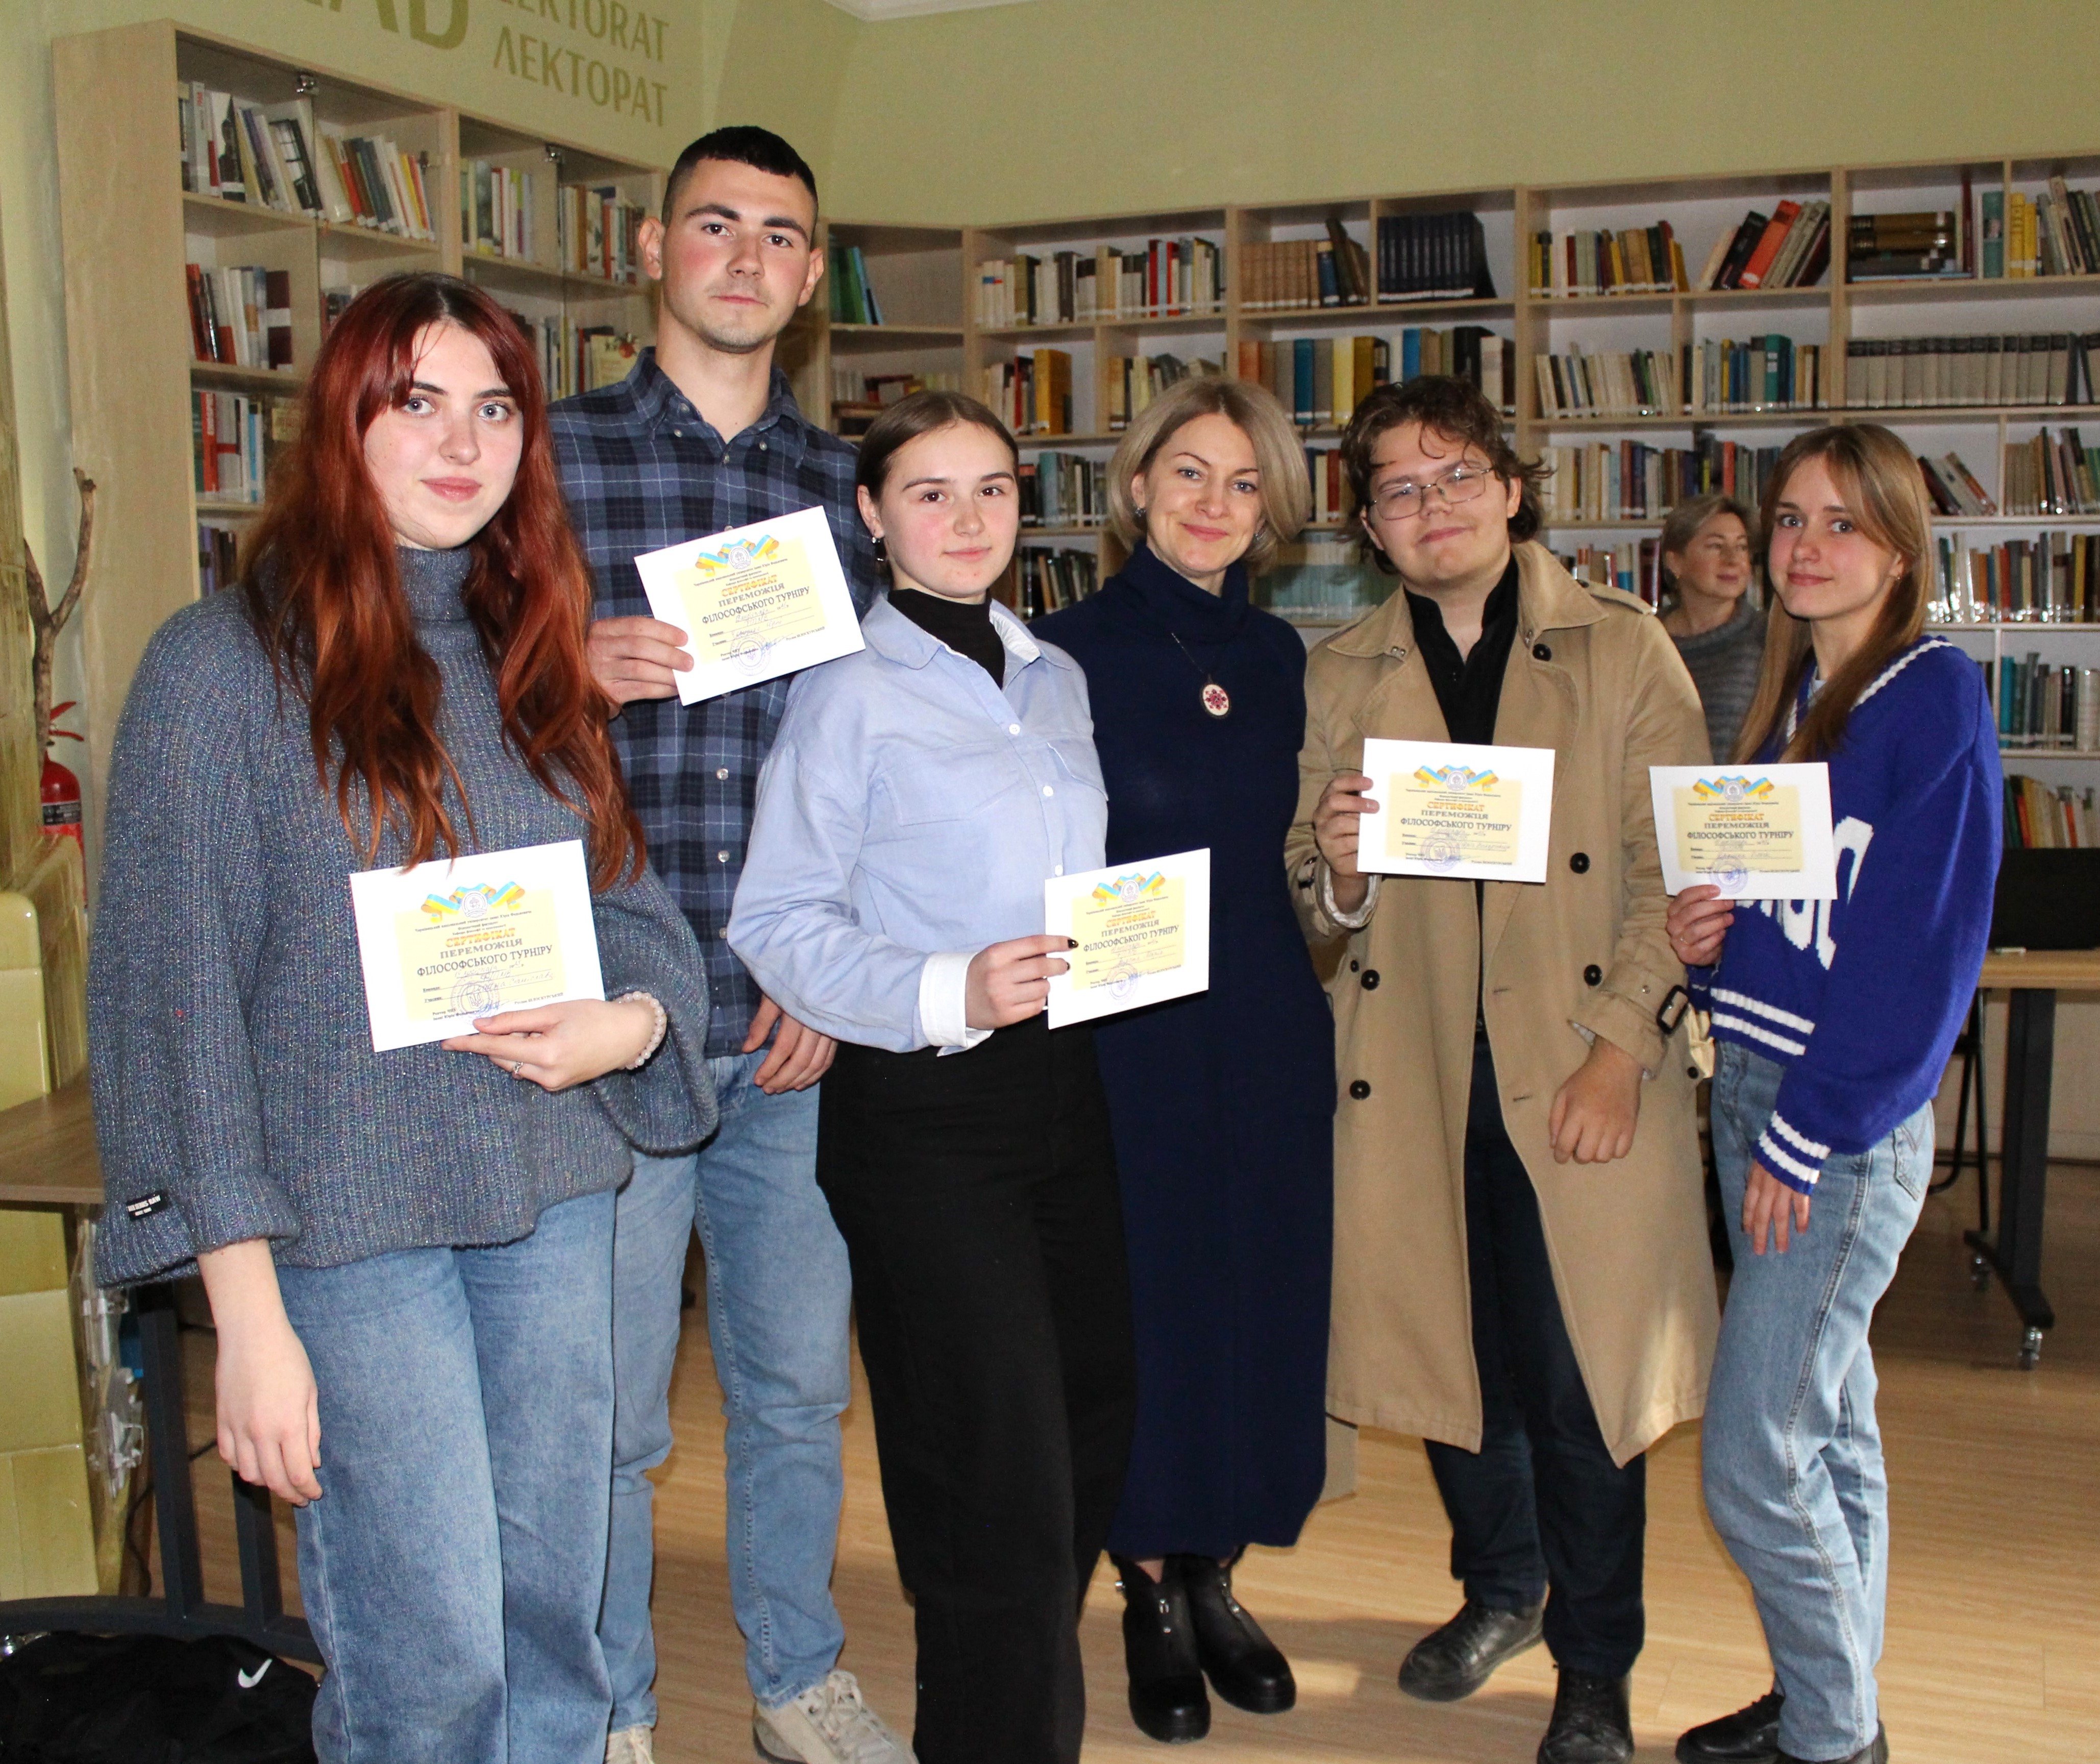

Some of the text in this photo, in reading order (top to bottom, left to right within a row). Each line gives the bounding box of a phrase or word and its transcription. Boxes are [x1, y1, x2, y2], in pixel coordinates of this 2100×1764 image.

[500, 0, 670, 63] TORAT
[493, 26, 668, 127] ЛЕКТОРАТ
[718, 582, 785, 607] ПЕРЕМОЖЦЯ
[722, 574, 777, 597] СЕРТИФІКАТ
[702, 597, 775, 624] ФІЛОСОФСЬКОГО
[776, 586, 809, 603] ТУРНІРУ
[1400, 818, 1474, 829] ФІЛОСОФСЬКОГО
[1476, 822, 1512, 831] ТУРНІРУ
[1421, 810, 1489, 820] ПЕРЕМОЖЦЯ
[1758, 831, 1794, 839] ТУРНІРУ
[446, 927, 515, 948] СЕРТИФІКАТ
[1083, 932, 1147, 952] ФІЛОСОФСЬКОГО
[1150, 924, 1179, 938] ТУРНІРУ
[1101, 919, 1159, 938] ПЕРЕМОЖЦЯ
[417, 952, 508, 976] ФІЛОСОФСЬКОГО
[509, 944, 553, 960] ТУРНІРУ
[440, 938, 523, 959] ПЕРЕМОЖЦЯ
